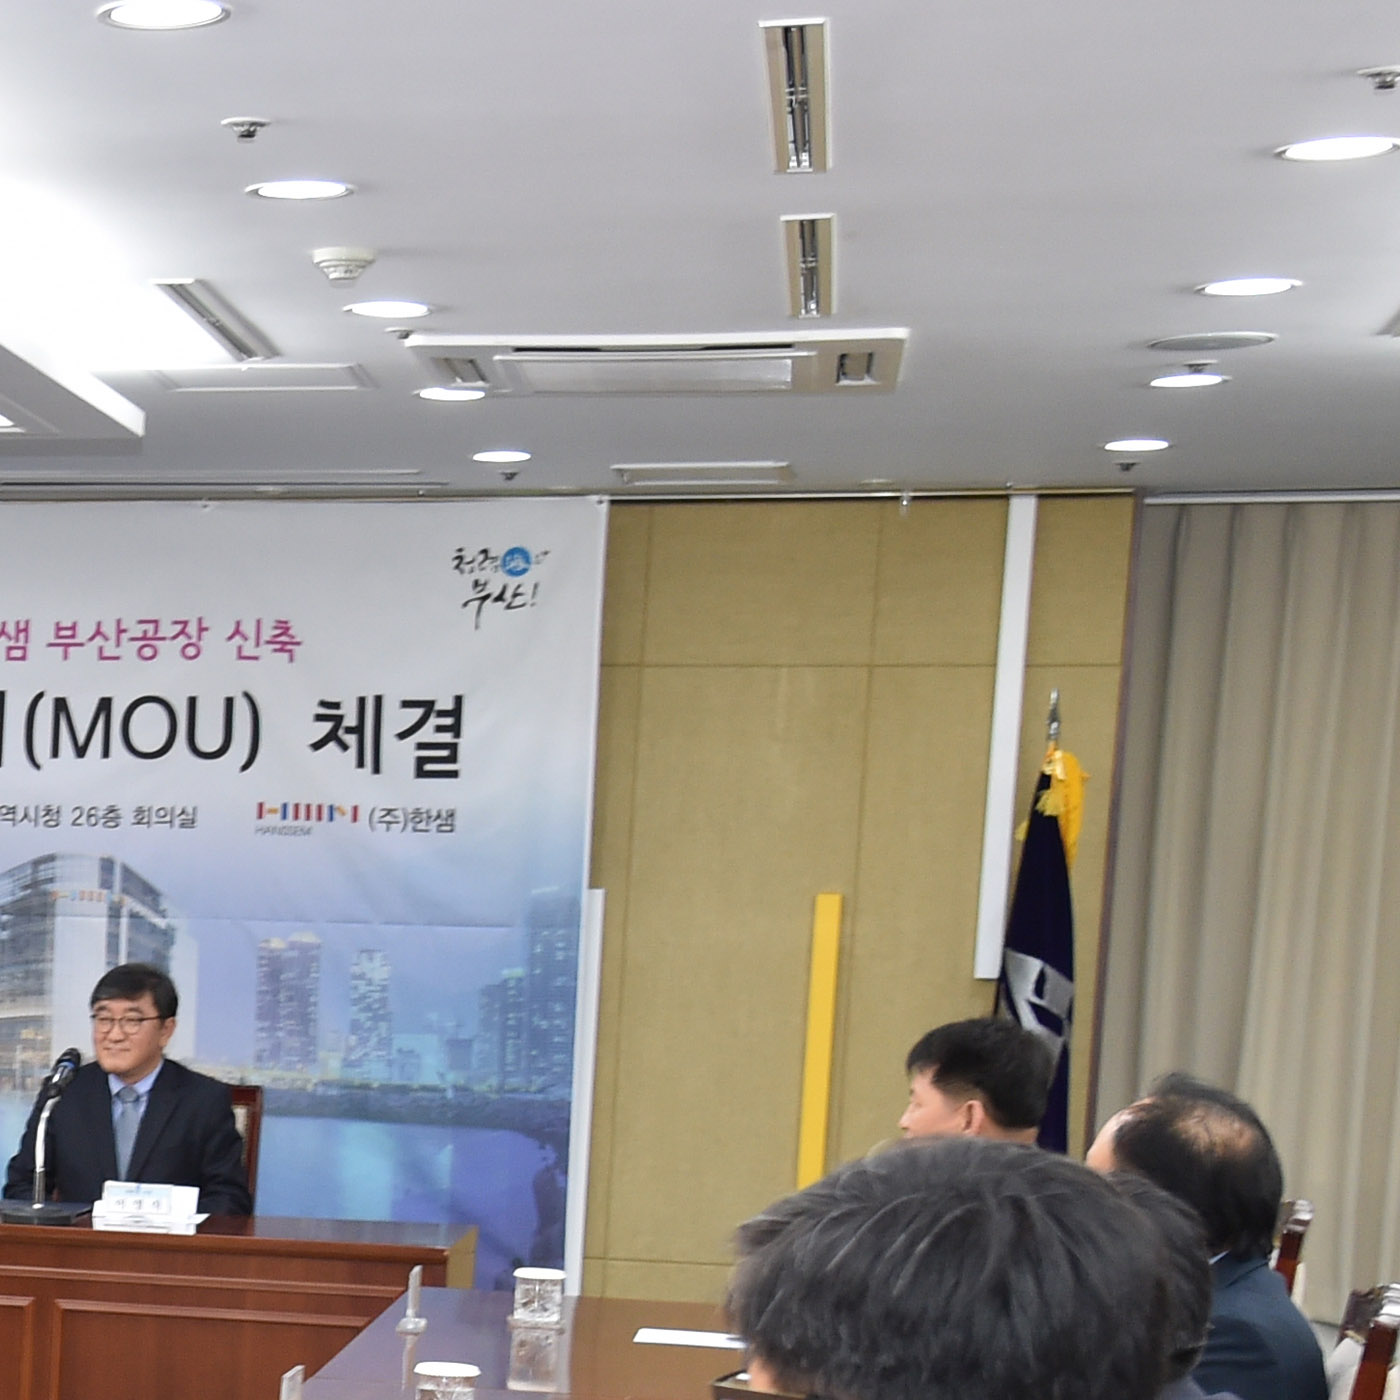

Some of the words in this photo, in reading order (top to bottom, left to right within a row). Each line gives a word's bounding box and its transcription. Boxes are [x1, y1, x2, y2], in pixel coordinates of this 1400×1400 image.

[46, 616, 210, 661] 부산공장
[226, 617, 303, 663] 신축
[308, 693, 465, 779] 체결
[70, 804, 123, 829] 26층
[130, 803, 199, 830] 회의실
[368, 806, 457, 834] (주)한샘
